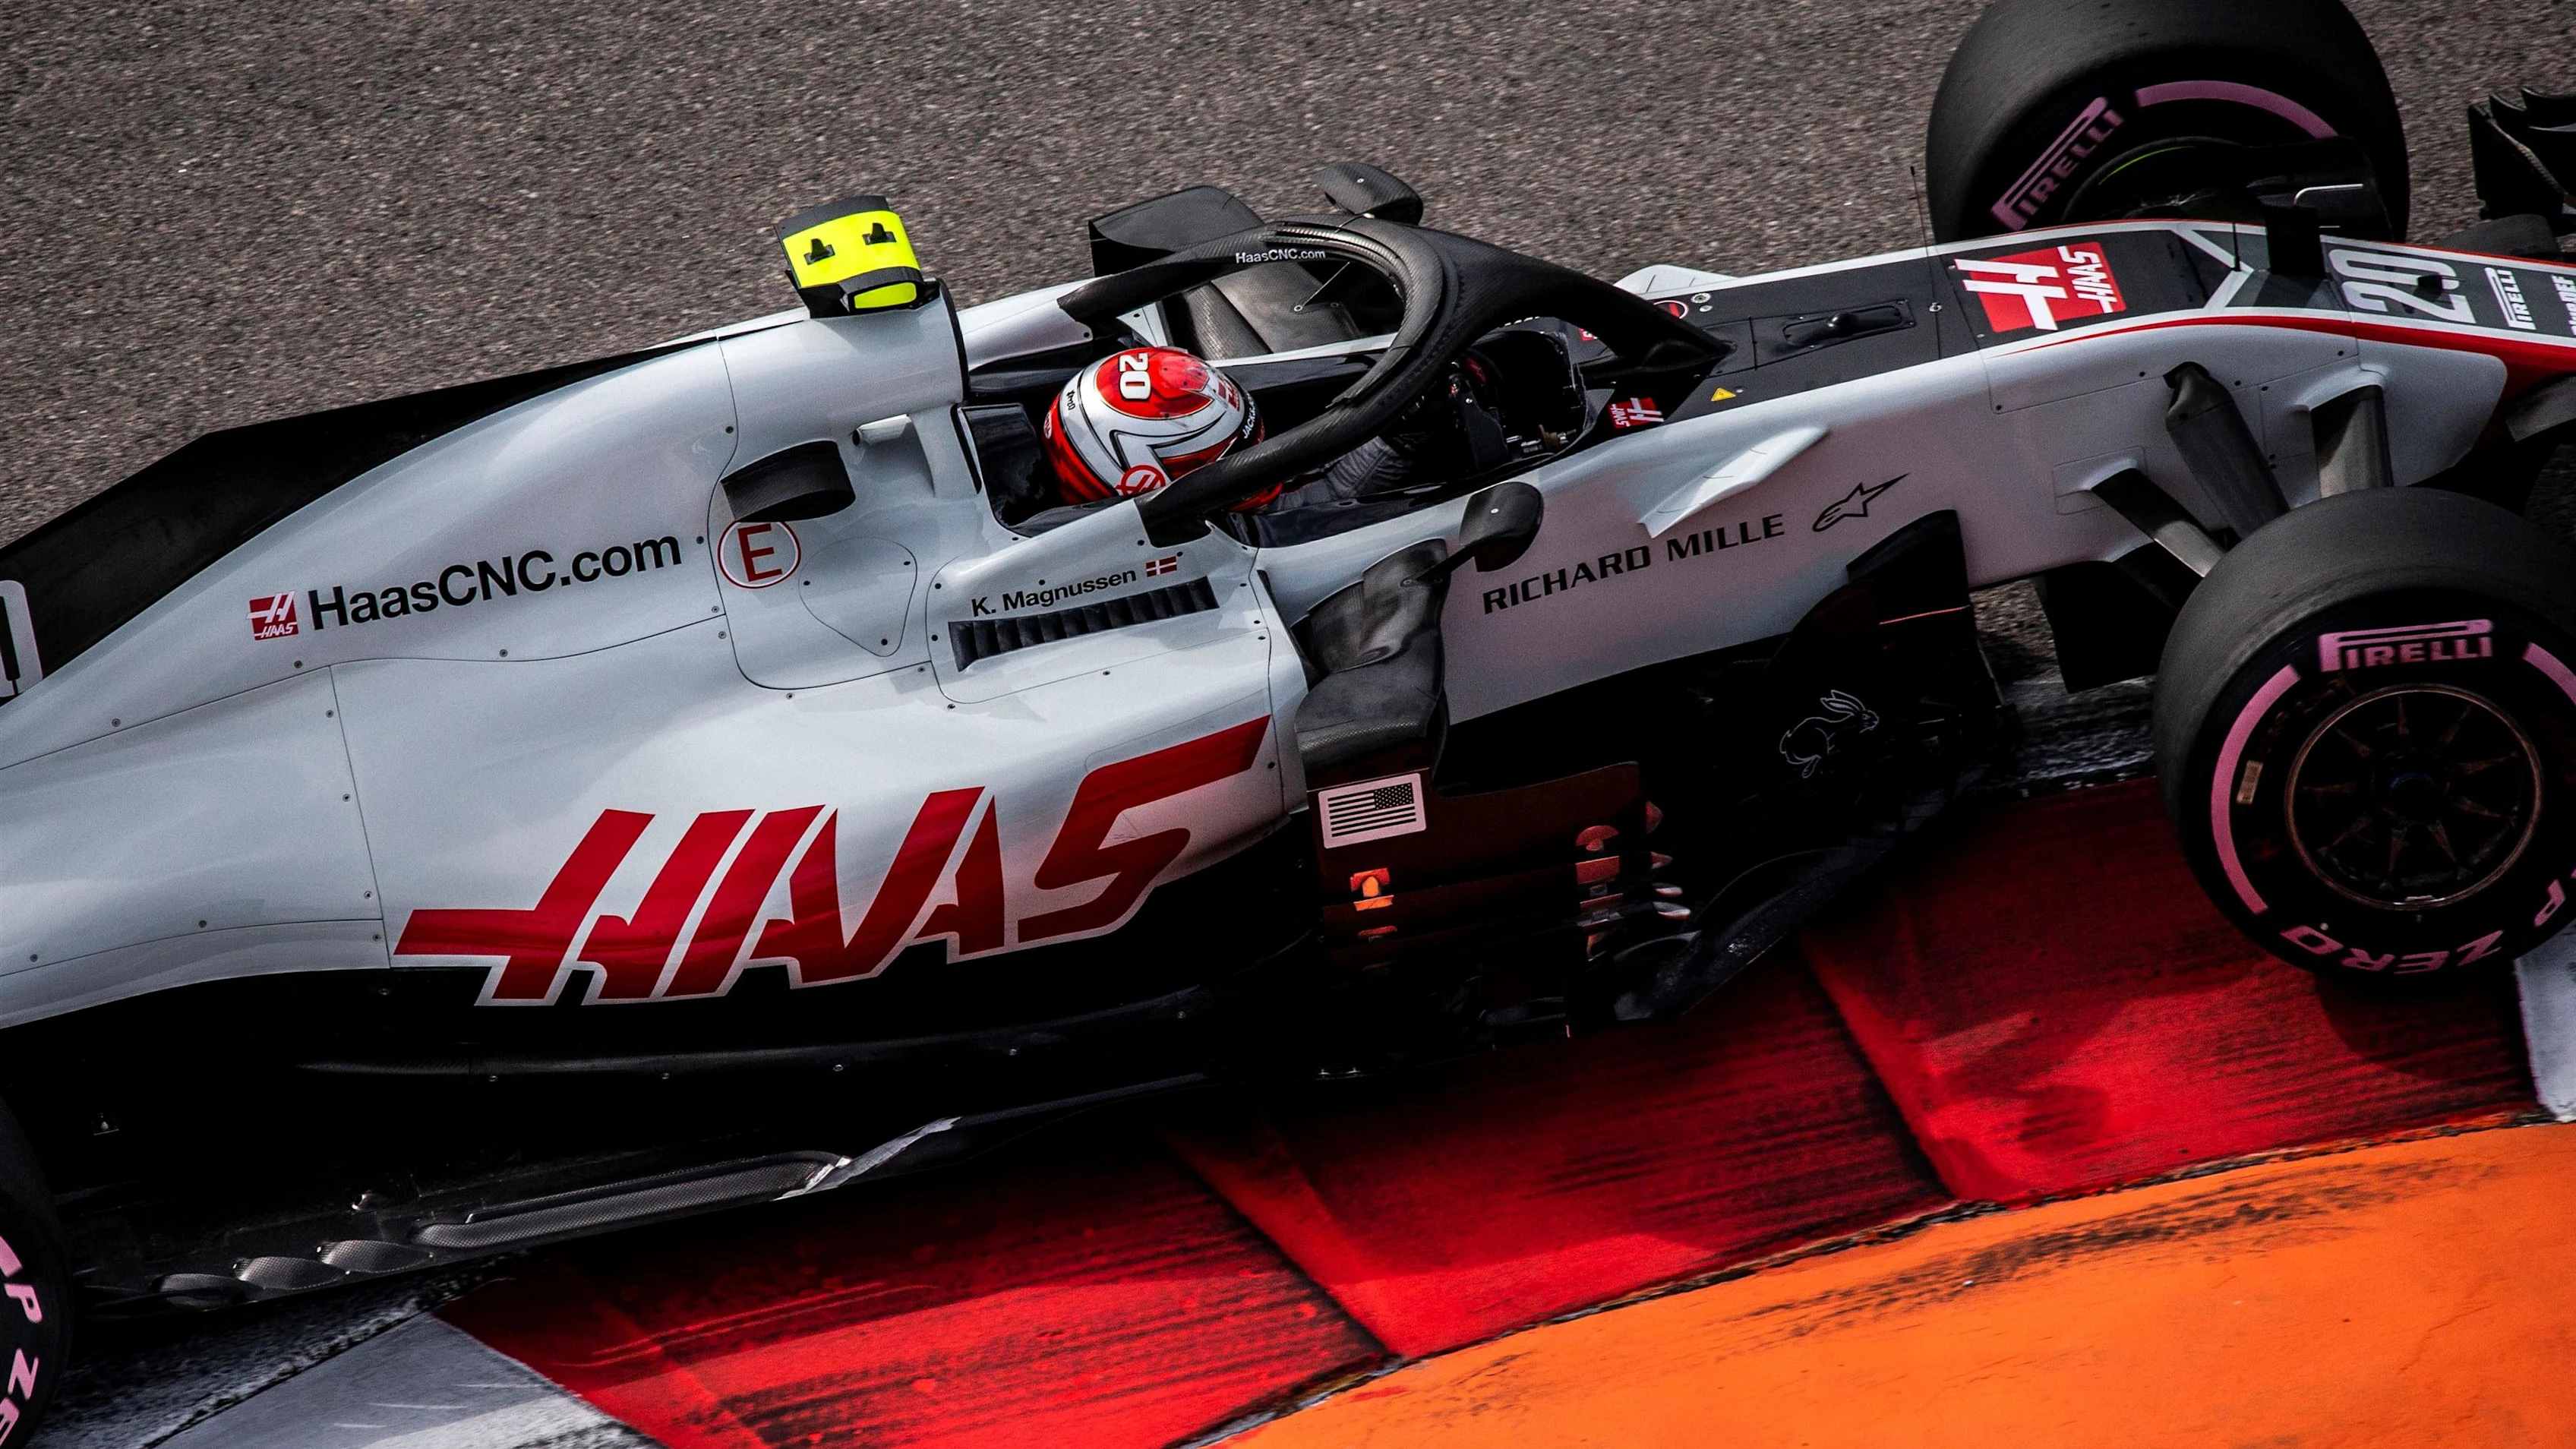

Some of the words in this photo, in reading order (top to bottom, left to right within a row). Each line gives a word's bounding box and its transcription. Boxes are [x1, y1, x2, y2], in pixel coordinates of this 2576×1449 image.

[1990, 96, 2124, 232] PIRELLI
[1235, 248, 1326, 264] HaasCNC.com
[2057, 245, 2118, 314] HAAS
[2328, 248, 2477, 324] 20
[2484, 267, 2537, 330] PIRELLI
[1119, 352, 1151, 400] 20
[737, 523, 783, 582] E
[1482, 545, 1651, 614] RICHARD
[1667, 513, 1785, 561] MILLE
[308, 535, 682, 630] HaasCNC.com
[971, 596, 996, 618] K.
[1003, 569, 1138, 611] Magnussen
[254, 621, 298, 639] HAAS
[2319, 619, 2493, 672] PIRELLI
[393, 715, 1271, 1001] HAAS
[2280, 925, 2505, 974] ZERO
[4, 1283, 43, 1324] P
